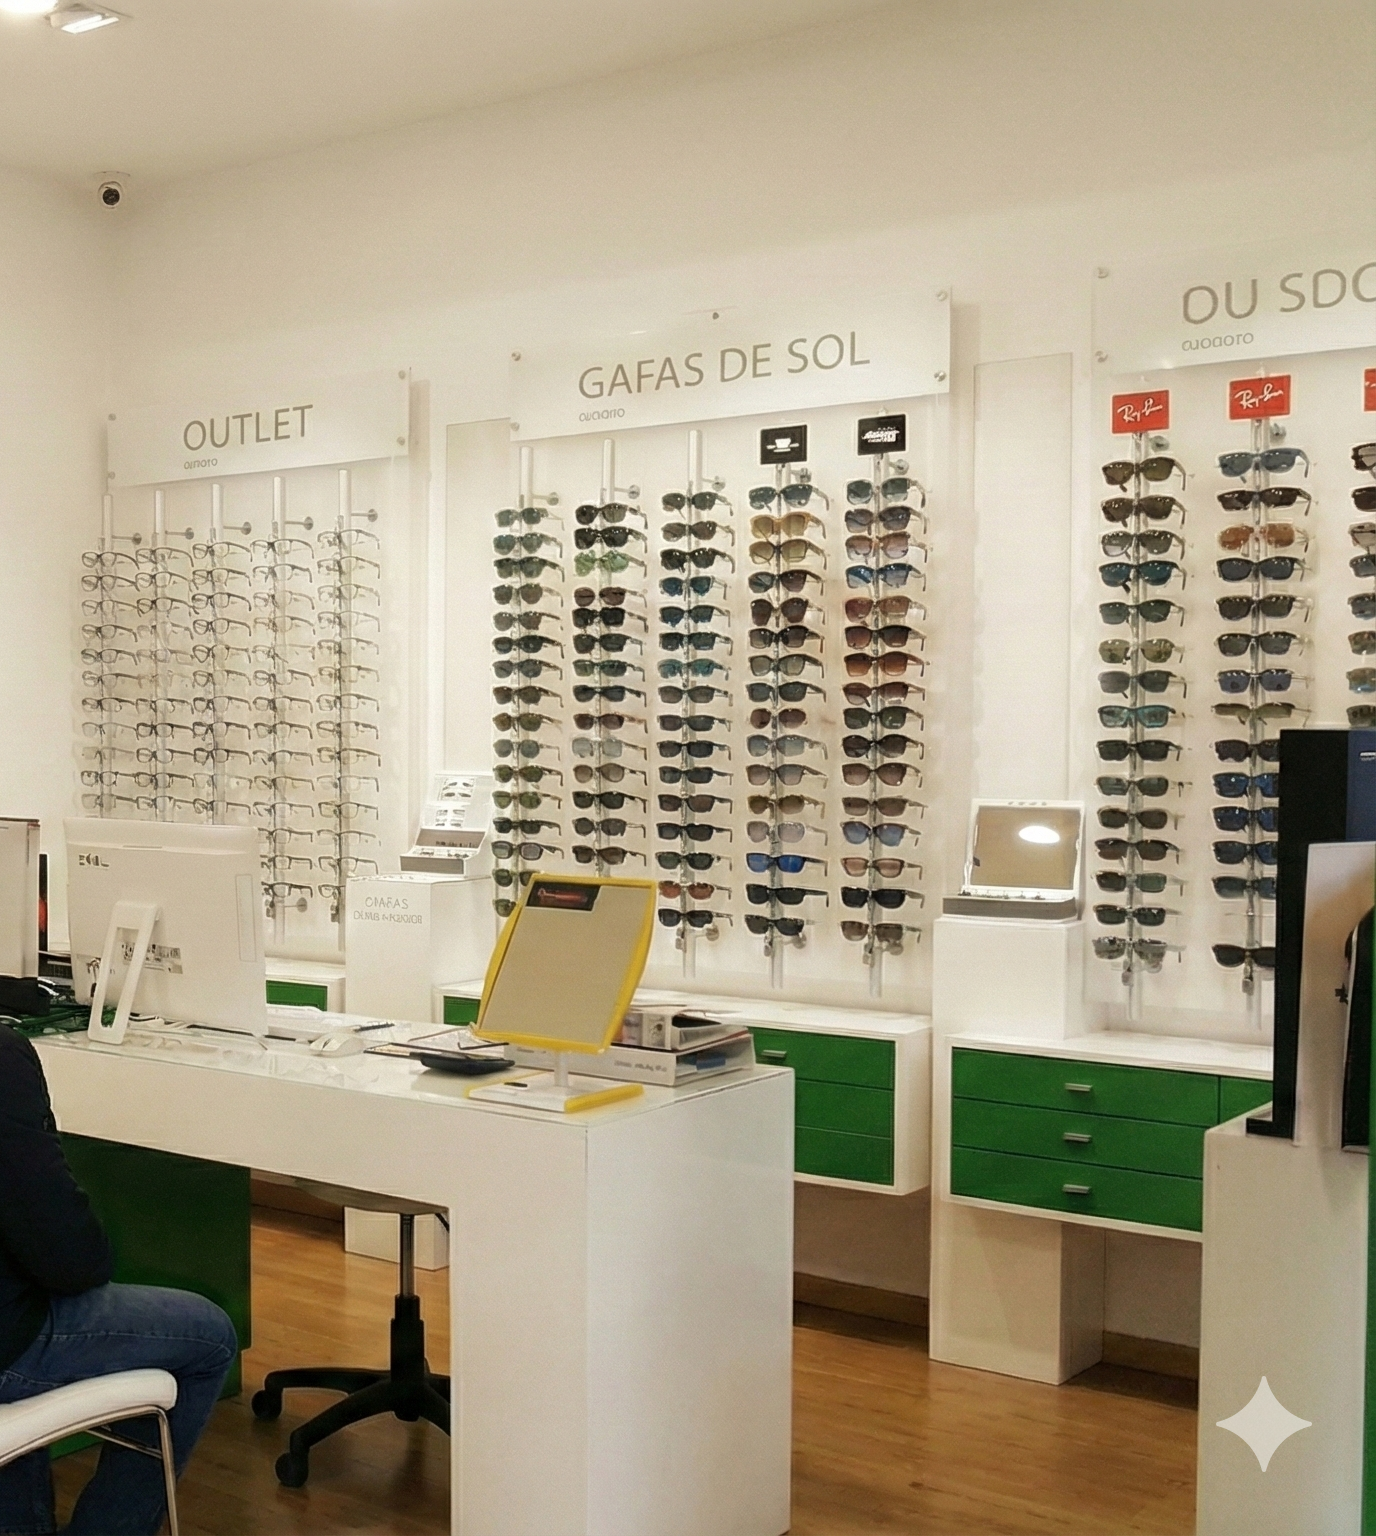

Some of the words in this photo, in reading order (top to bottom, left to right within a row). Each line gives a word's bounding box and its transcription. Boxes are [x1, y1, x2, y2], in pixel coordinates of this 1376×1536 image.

[578, 352, 705, 399] GAFAS
[720, 343, 772, 383] DE
[787, 331, 871, 374] SOL
[183, 404, 314, 452] OUTLET
